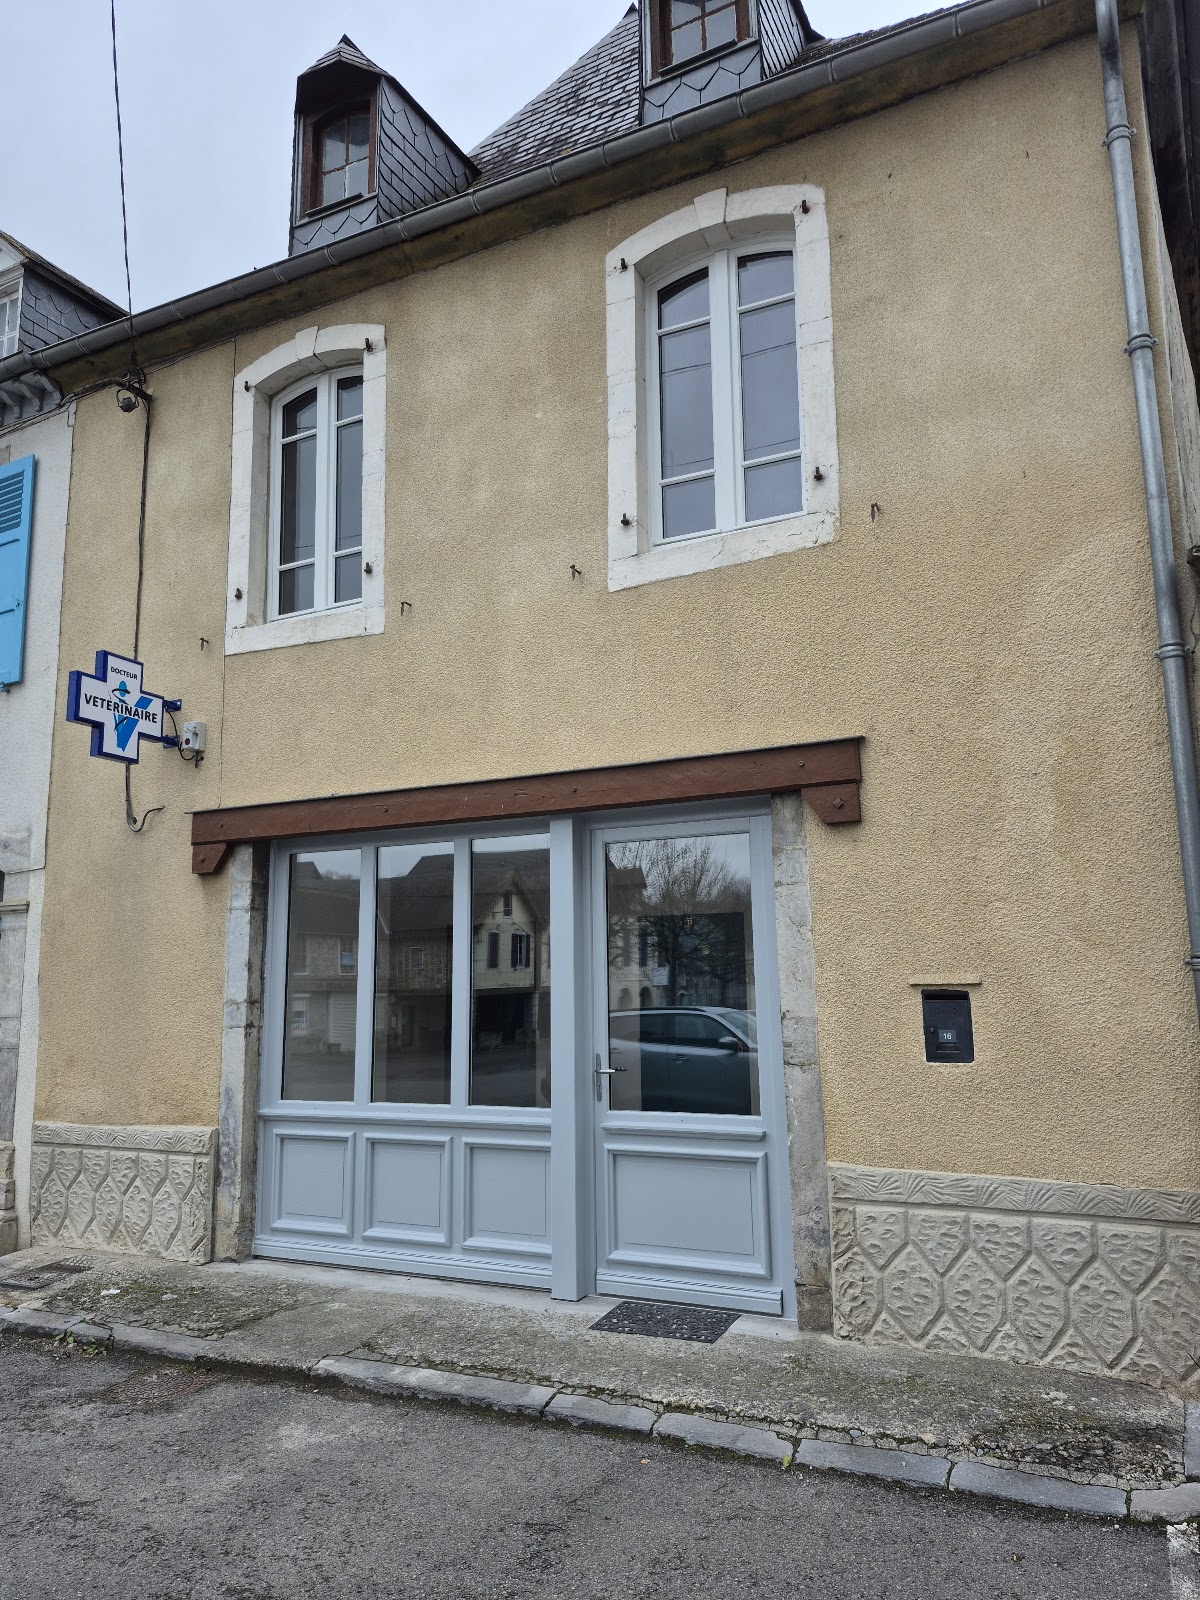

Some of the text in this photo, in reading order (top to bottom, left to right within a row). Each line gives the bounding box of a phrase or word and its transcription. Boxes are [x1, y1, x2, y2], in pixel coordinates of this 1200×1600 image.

[110, 666, 138, 680] DOCTEUR
[84, 693, 158, 724] VETERINAIRE
[943, 1032, 952, 1040] 16
